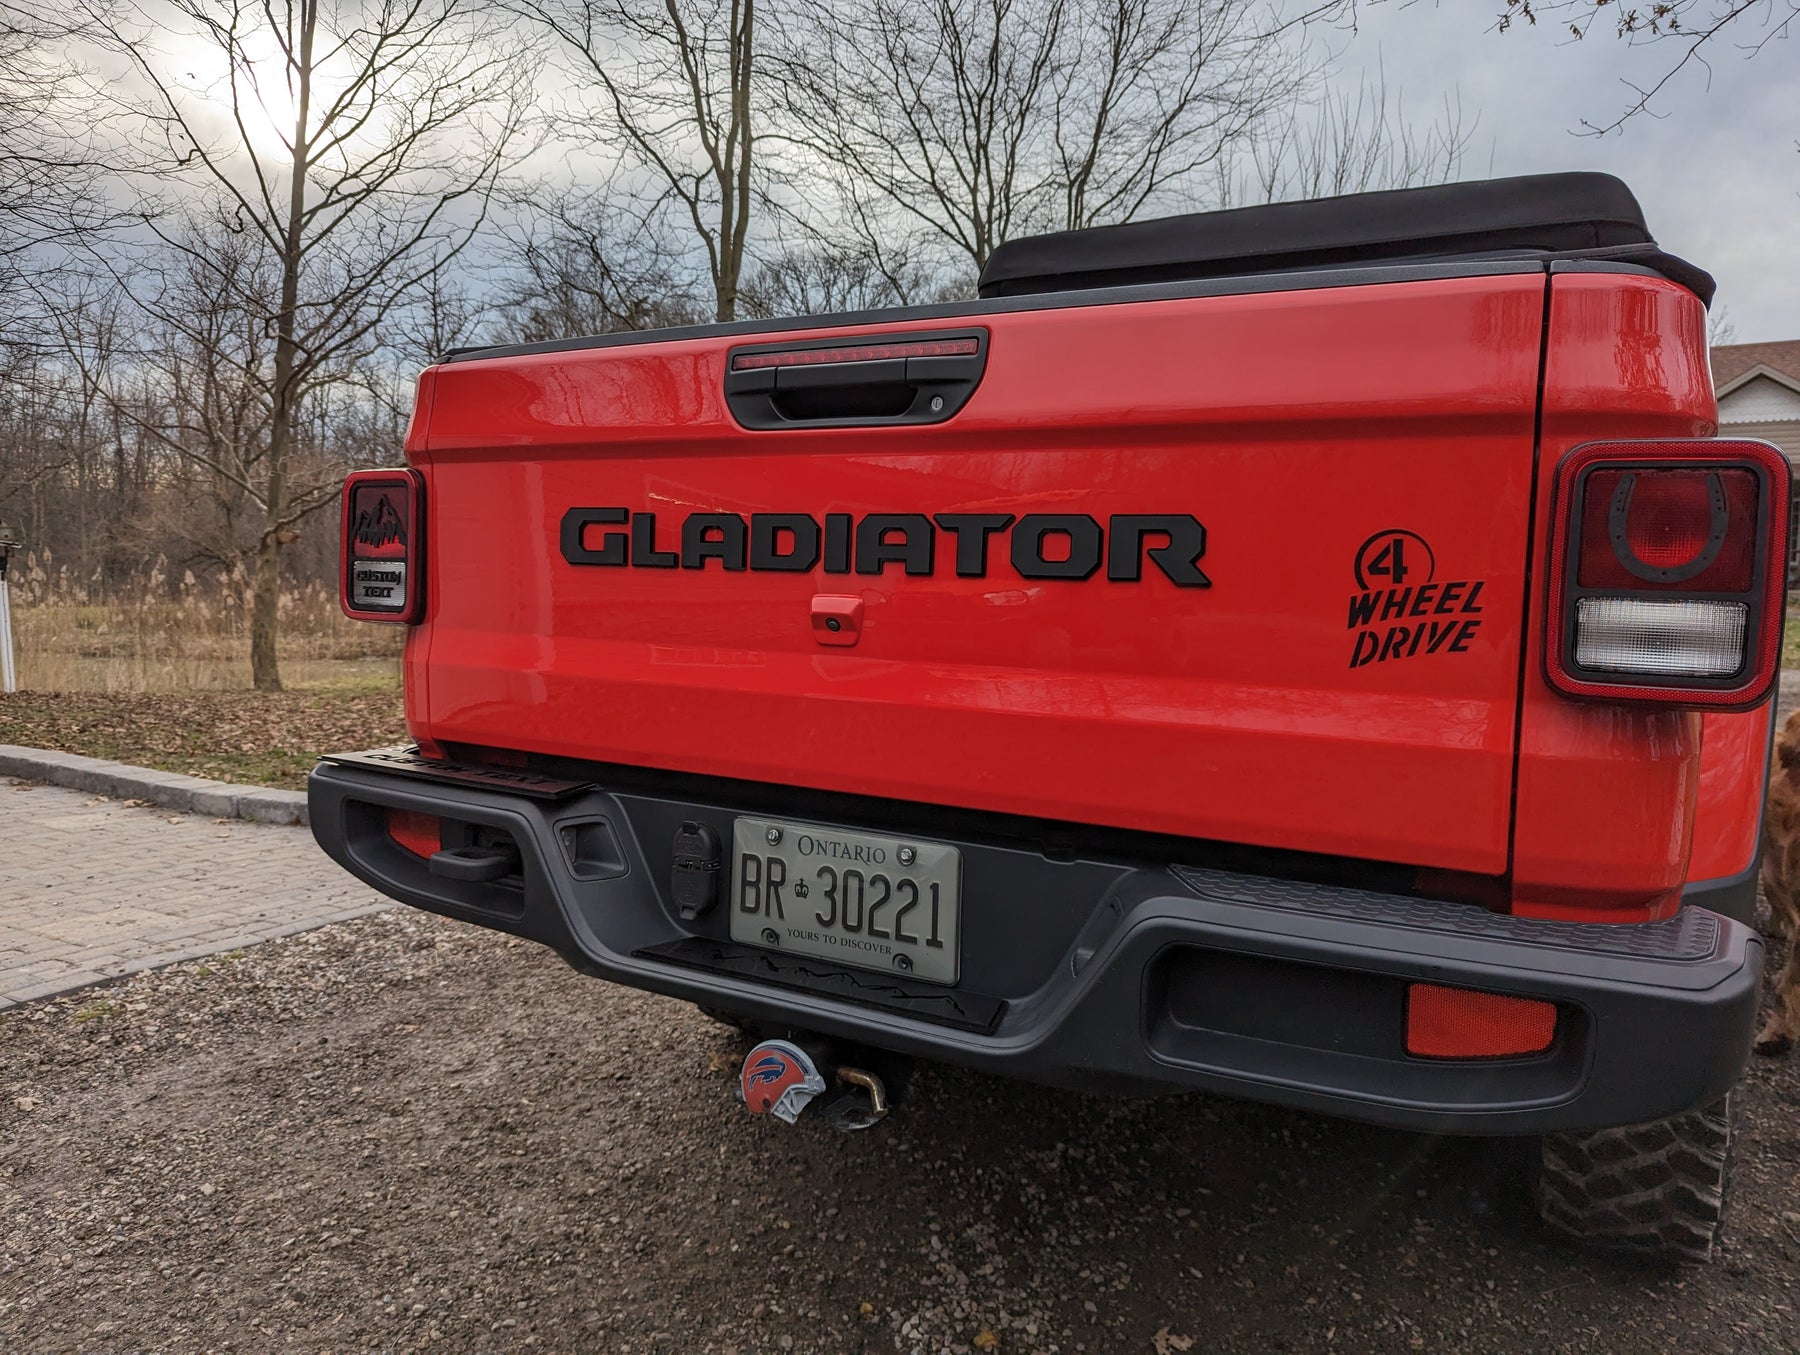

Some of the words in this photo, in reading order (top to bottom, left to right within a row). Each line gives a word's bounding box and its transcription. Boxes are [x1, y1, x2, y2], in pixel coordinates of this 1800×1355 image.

[560, 506, 1212, 588] GLADIATOR
[1367, 538, 1408, 584] 4
[363, 587, 394, 598] TEXT
[1347, 581, 1485, 629] WHEEL
[1349, 619, 1482, 669] DRIVE
[740, 852, 786, 920] BR
[815, 865, 943, 949] 30221
[786, 927, 819, 942] YOURS
[823, 934, 837, 945] TO
[839, 937, 892, 955] DISCOVER
